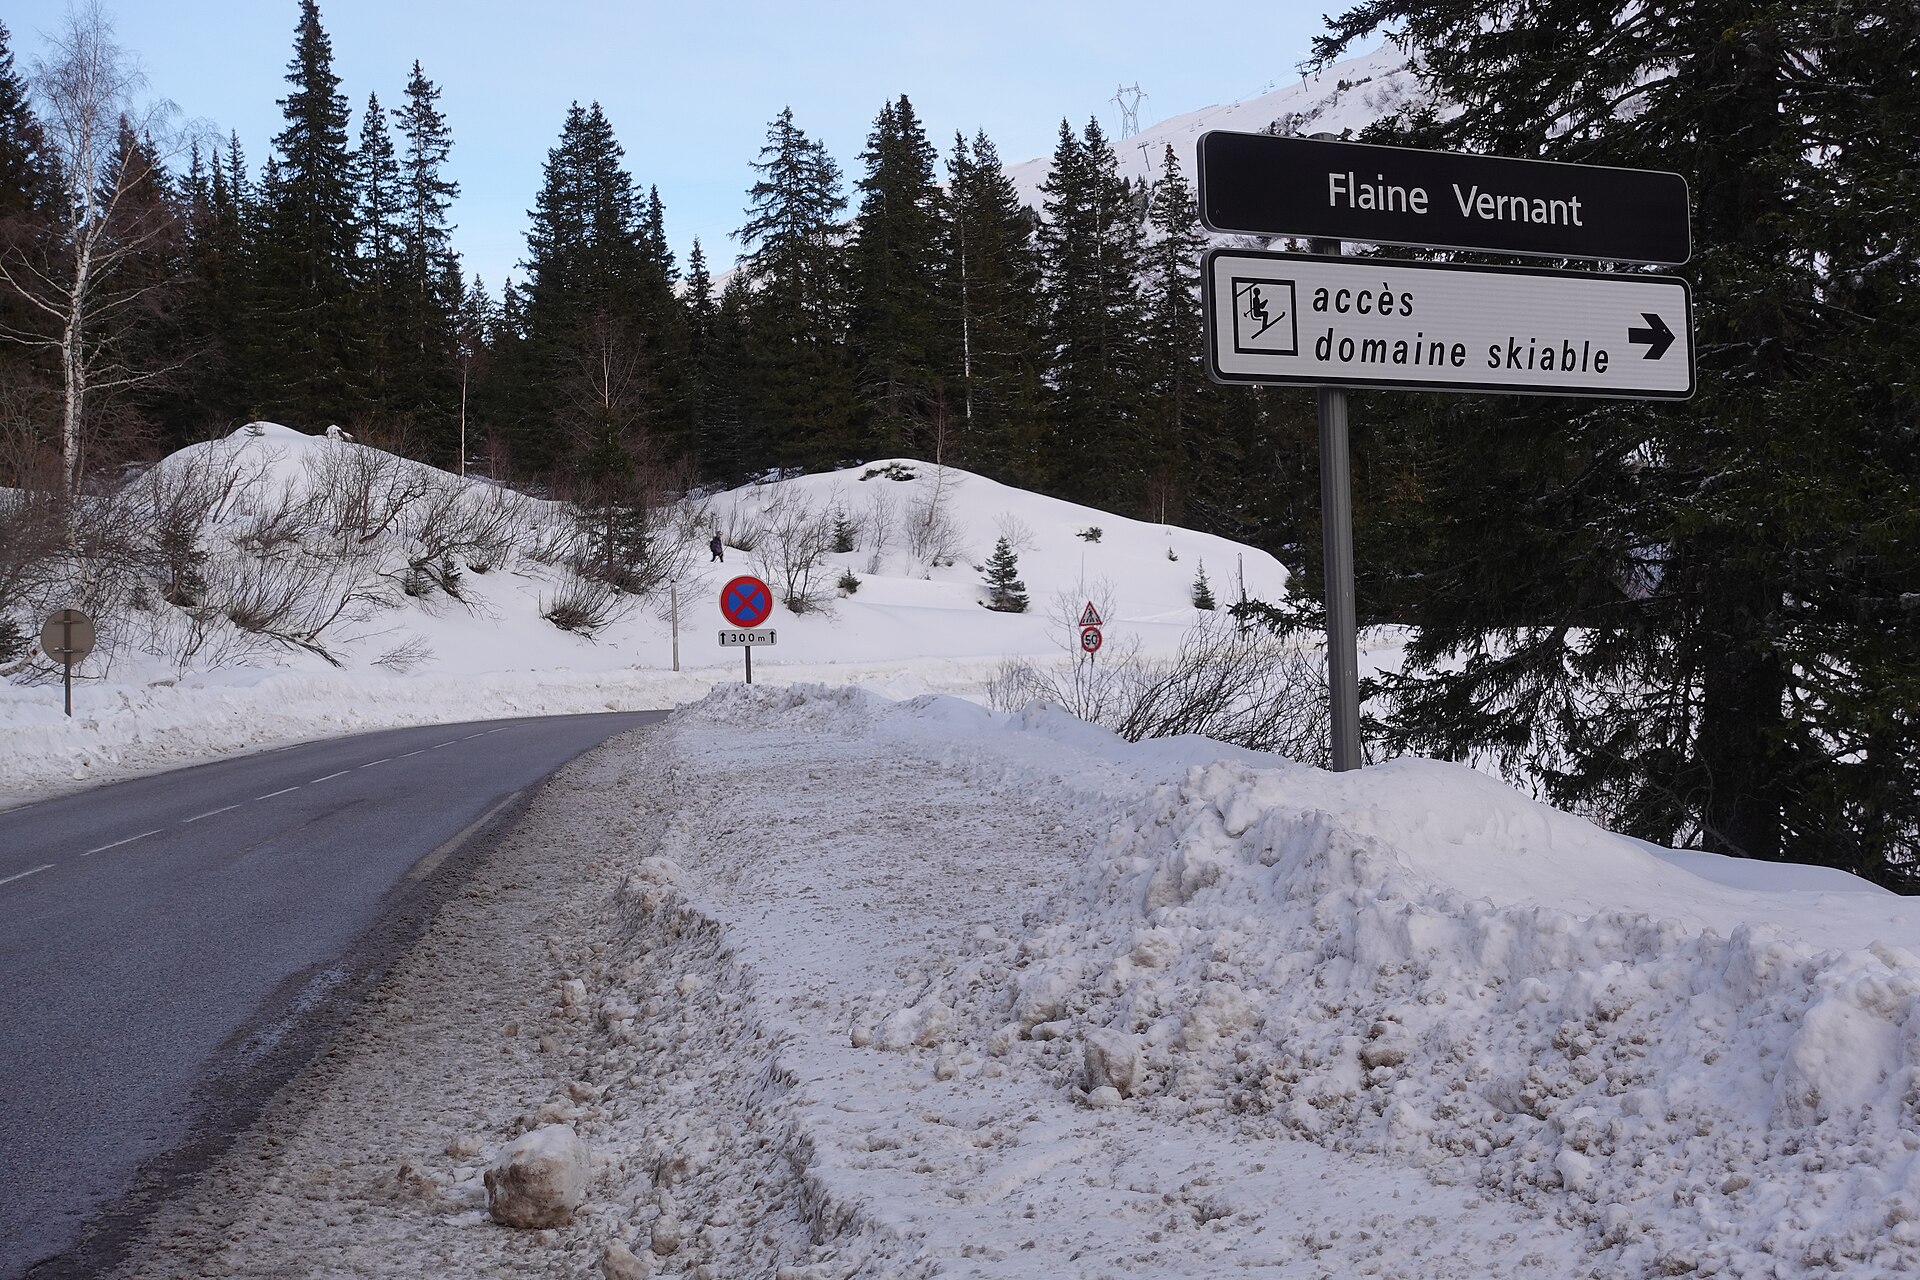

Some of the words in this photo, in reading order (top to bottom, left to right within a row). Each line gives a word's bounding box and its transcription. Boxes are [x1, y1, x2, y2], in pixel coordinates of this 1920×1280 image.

[1327, 171, 1429, 214] Flaine
[1452, 183, 1583, 227] Vernant
[1312, 282, 1414, 317] accès
[1314, 327, 1466, 367] domaine
[1487, 336, 1609, 374] skiable
[731, 633, 755, 642] 300
[1085, 634, 1098, 646] 50
